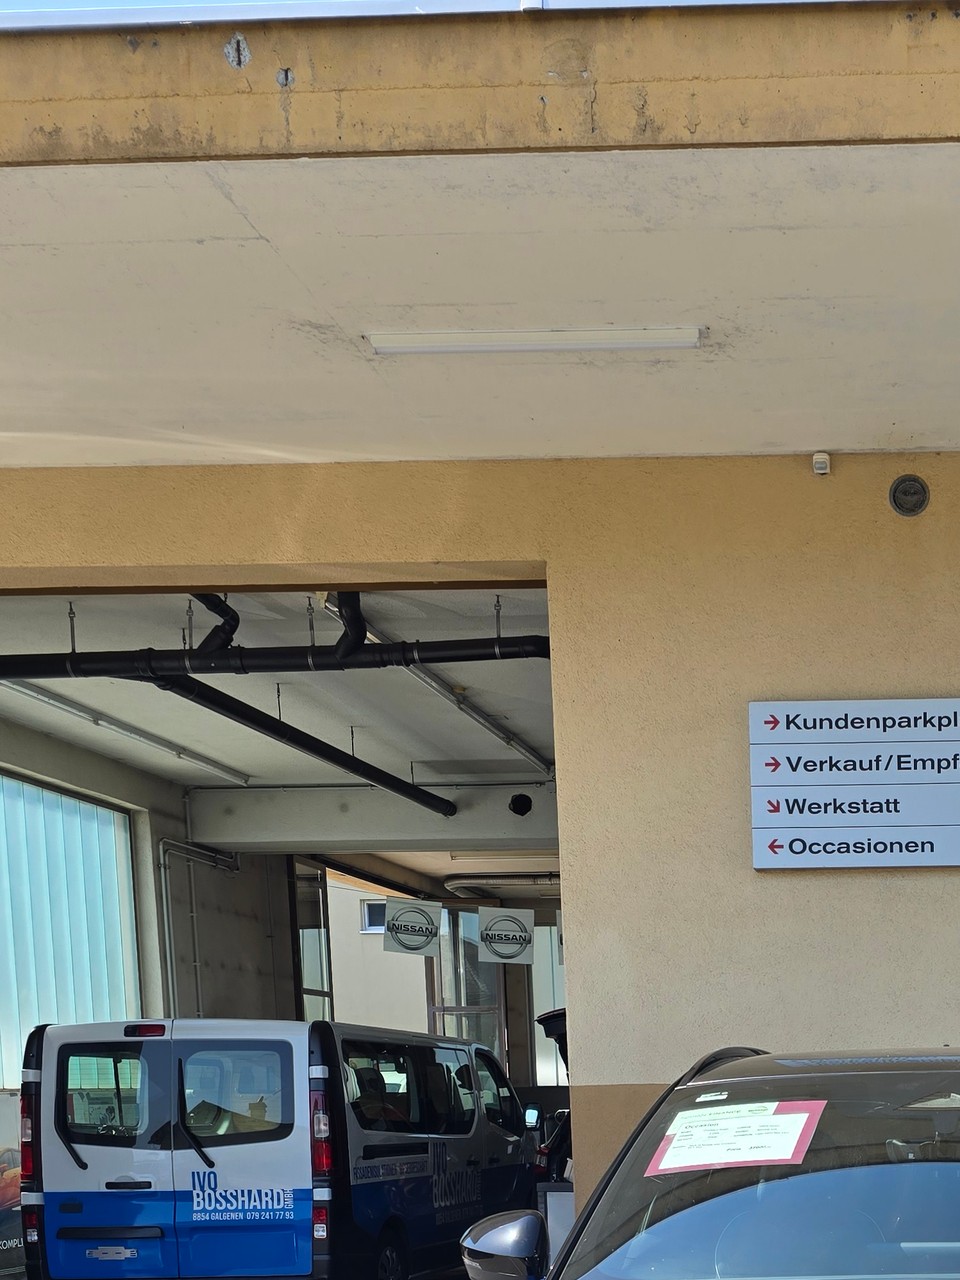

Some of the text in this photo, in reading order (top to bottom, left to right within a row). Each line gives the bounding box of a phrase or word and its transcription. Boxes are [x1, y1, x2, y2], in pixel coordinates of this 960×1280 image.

[785, 798, 901, 815] Werkstatt
[788, 838, 935, 855] Occasionen
[391, 922, 433, 934] NISSAN
[485, 932, 527, 942] NISSAN
[191, 1171, 218, 1190] IVO
[192, 1189, 285, 1211] BOSSHARD
[192, 1213, 210, 1221] 8854
[210, 1212, 243, 1220] GALGENEN
[246, 1212, 259, 1220] 079
[261, 1212, 273, 1220] 241
[285, 1211, 294, 1219] 93
